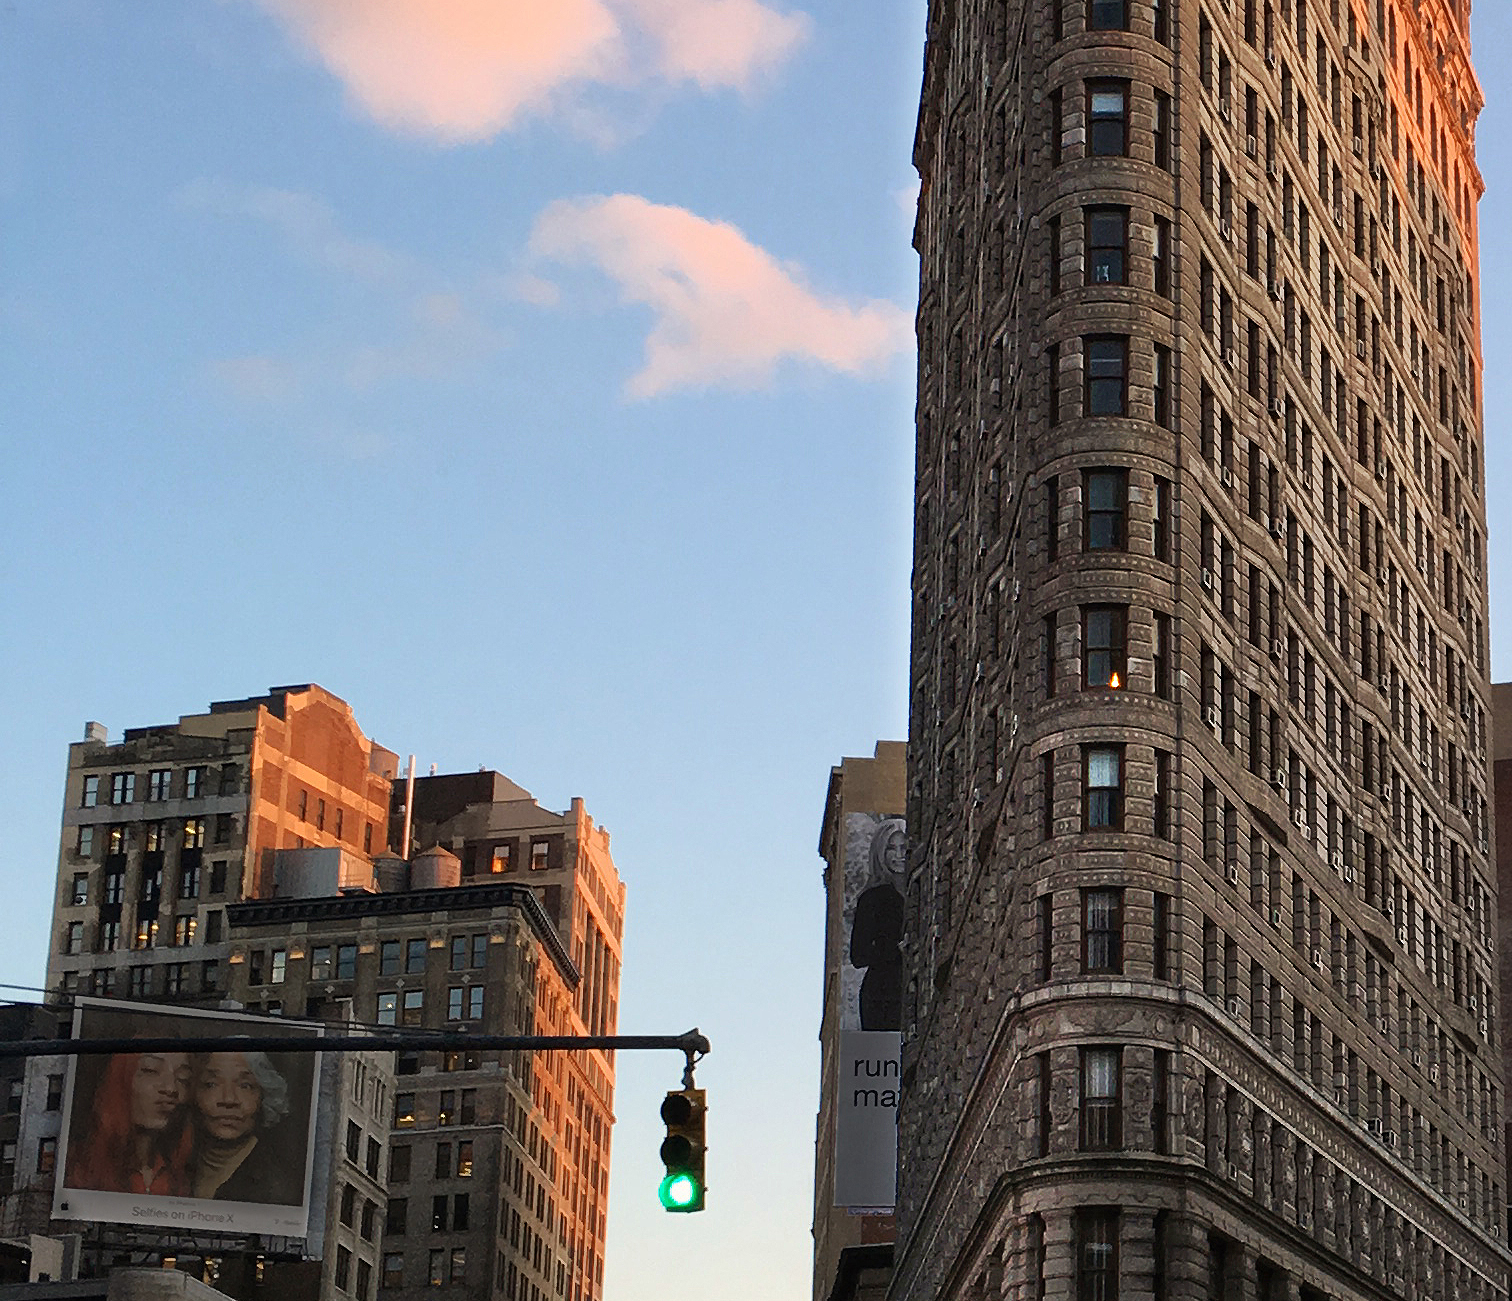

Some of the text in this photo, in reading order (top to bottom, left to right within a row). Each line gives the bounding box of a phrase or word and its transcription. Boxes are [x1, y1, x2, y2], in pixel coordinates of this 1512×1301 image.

[854, 1090, 900, 1107] ma
[131, 1205, 235, 1224] Selfies on iPhone X
